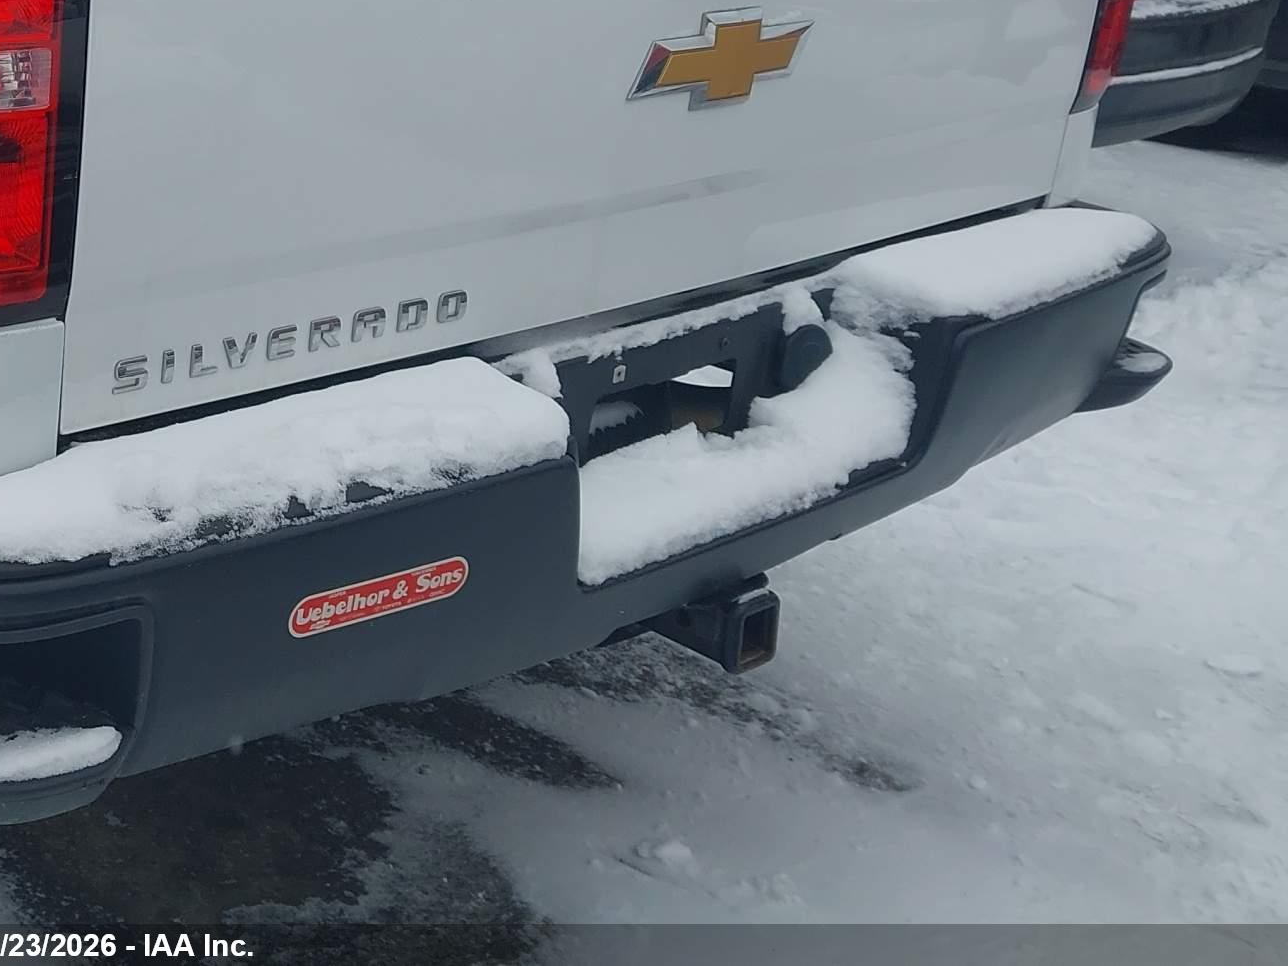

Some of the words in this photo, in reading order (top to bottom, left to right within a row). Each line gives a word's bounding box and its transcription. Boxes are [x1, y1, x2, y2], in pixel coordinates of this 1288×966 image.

[112, 289, 469, 394] SILVERADO
[295, 588, 391, 626] Uebelhor
[392, 580, 409, 600] &
[415, 567, 464, 593] Sons
